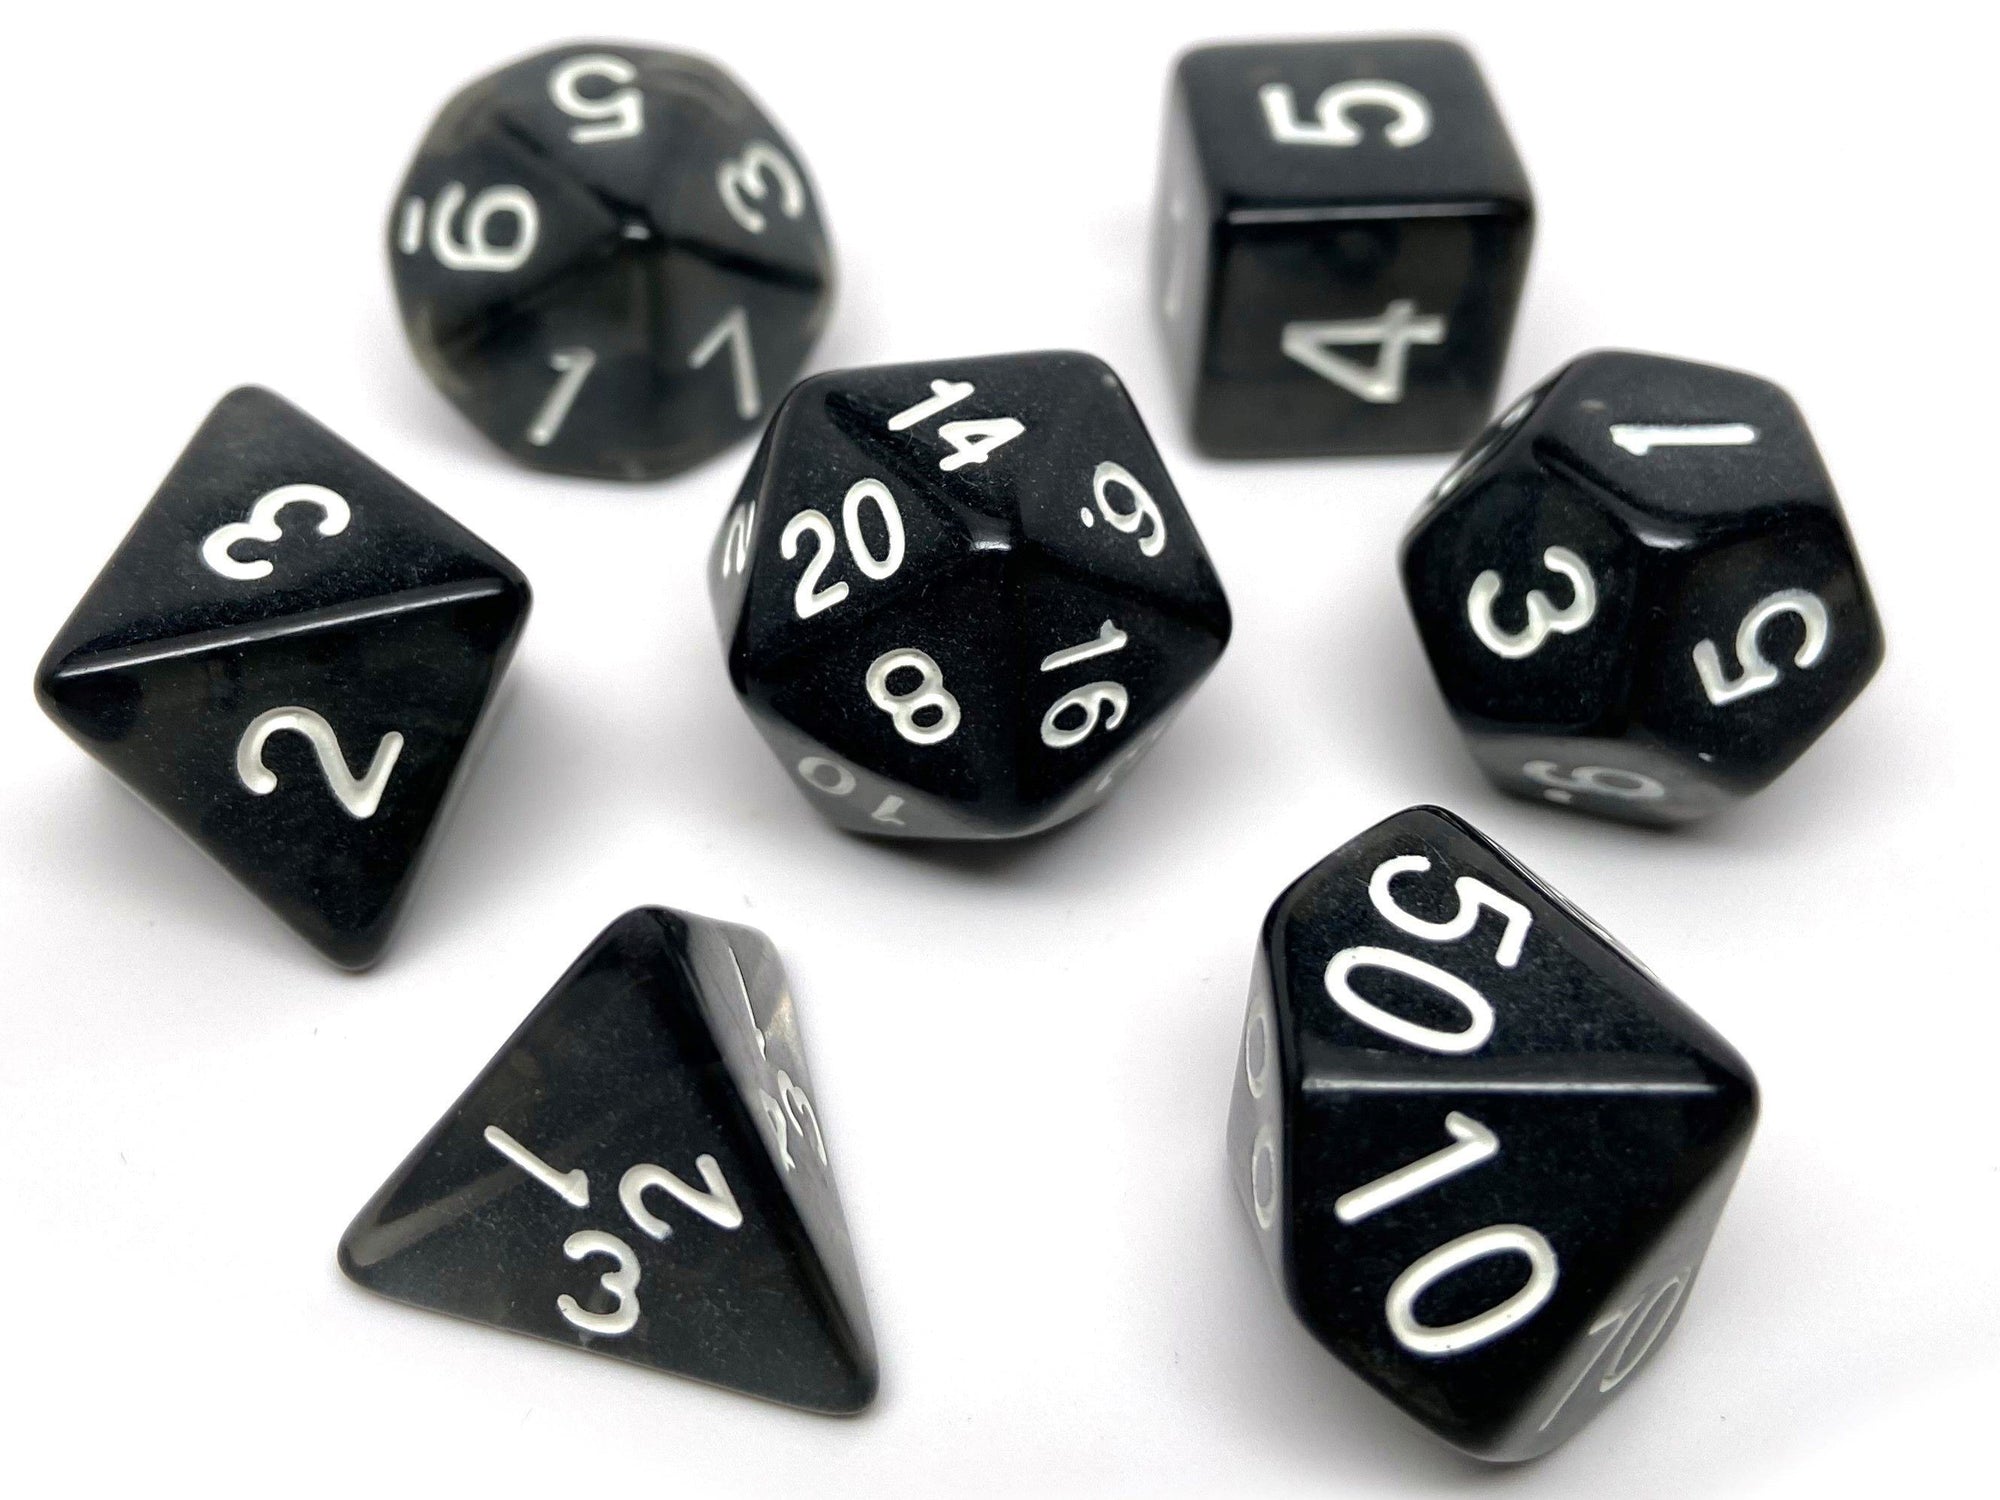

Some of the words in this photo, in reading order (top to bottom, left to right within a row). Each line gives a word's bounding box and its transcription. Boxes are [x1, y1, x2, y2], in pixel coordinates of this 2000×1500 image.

[547, 53, 645, 144] 5
[1259, 80, 1431, 147] 5
[716, 140, 806, 234] 3
[528, 349, 595, 445] 1
[691, 309, 761, 418] 7
[1283, 303, 1444, 403] 4
[888, 379, 1026, 471] 14
[1610, 423, 1757, 456] 1
[201, 484, 351, 580] 3
[781, 478, 905, 619] 20
[1467, 546, 1597, 659] 3
[1693, 589, 1829, 705] 5
[866, 648, 961, 744] 8
[1040, 620, 1128, 747] 16
[236, 706, 404, 819] 2
[1324, 855, 1533, 1052] 50
[484, 1126, 589, 1208] 1
[619, 1154, 742, 1240] 2
[557, 1230, 641, 1334] 3
[1335, 1112, 1557, 1354] 10
[1537, 1266, 1691, 1433] 70
